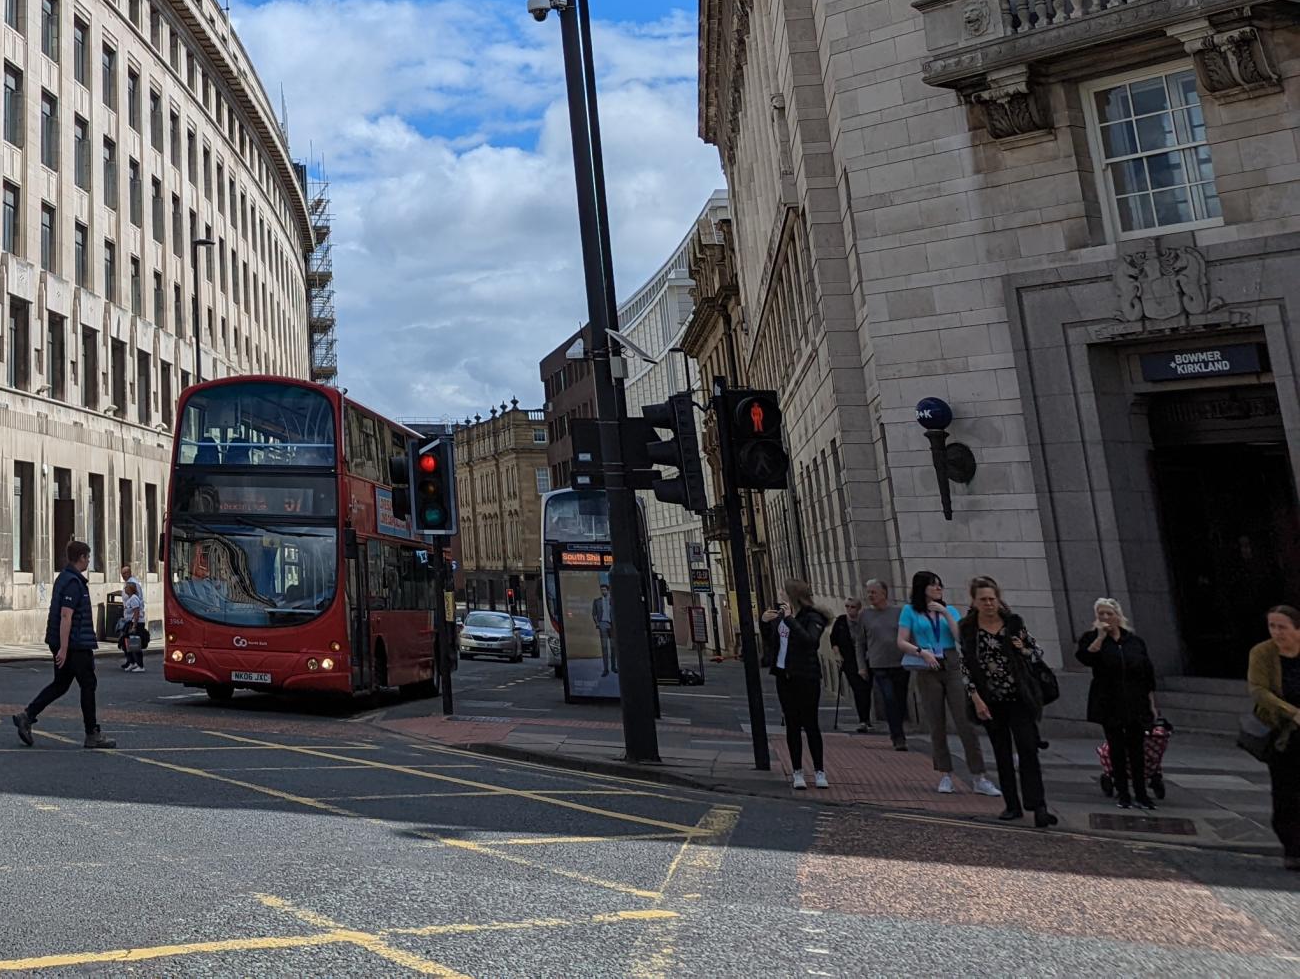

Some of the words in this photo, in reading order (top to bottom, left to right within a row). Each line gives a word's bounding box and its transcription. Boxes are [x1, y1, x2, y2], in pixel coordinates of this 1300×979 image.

[1174, 350, 1222, 364] BOWMER
[1176, 360, 1230, 374] KIRKLAND
[562, 552, 585, 561] South
[234, 672, 253, 681] NK06
